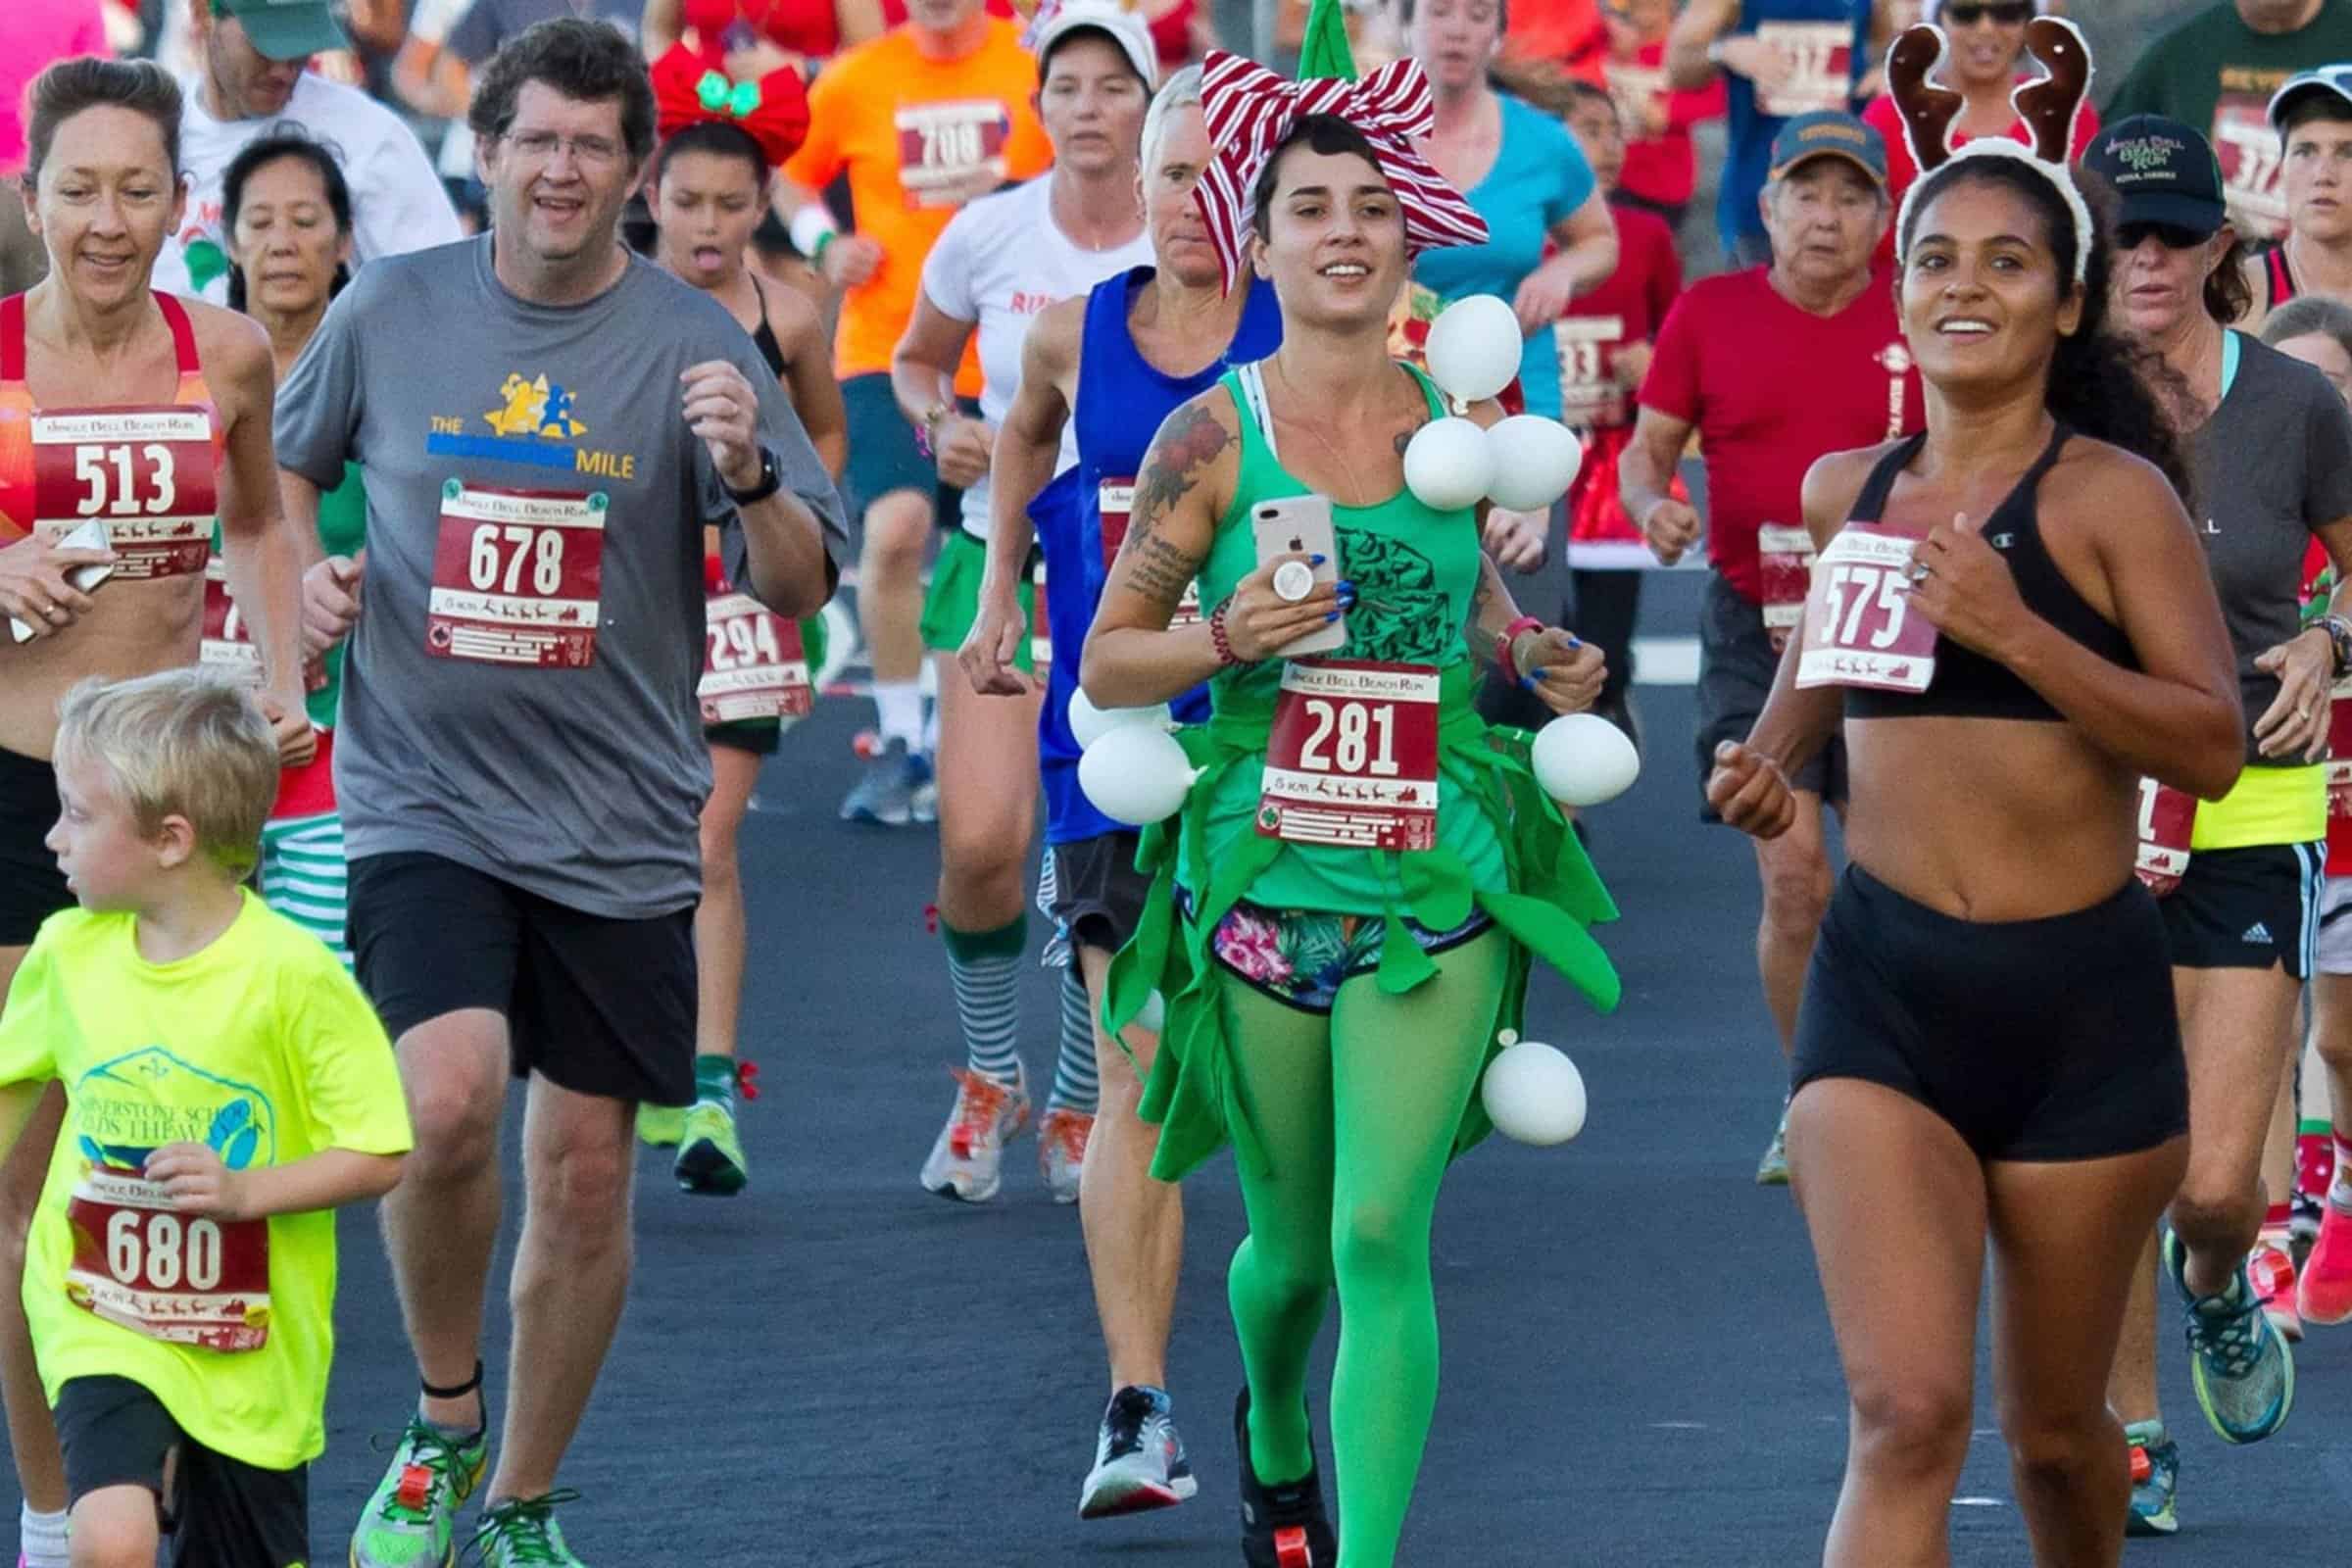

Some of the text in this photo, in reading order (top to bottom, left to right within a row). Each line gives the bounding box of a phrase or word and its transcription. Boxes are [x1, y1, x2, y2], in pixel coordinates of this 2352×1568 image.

[431, 416, 465, 435] THE
[75, 444, 176, 516] 513
[576, 450, 636, 480] MILE
[469, 523, 564, 597] 678
[707, 613, 780, 672] 294
[1820, 564, 1912, 650] 575
[1398, 677, 1426, 692] RUN
[1299, 700, 1399, 776] 281
[107, 1210, 221, 1291] 680
